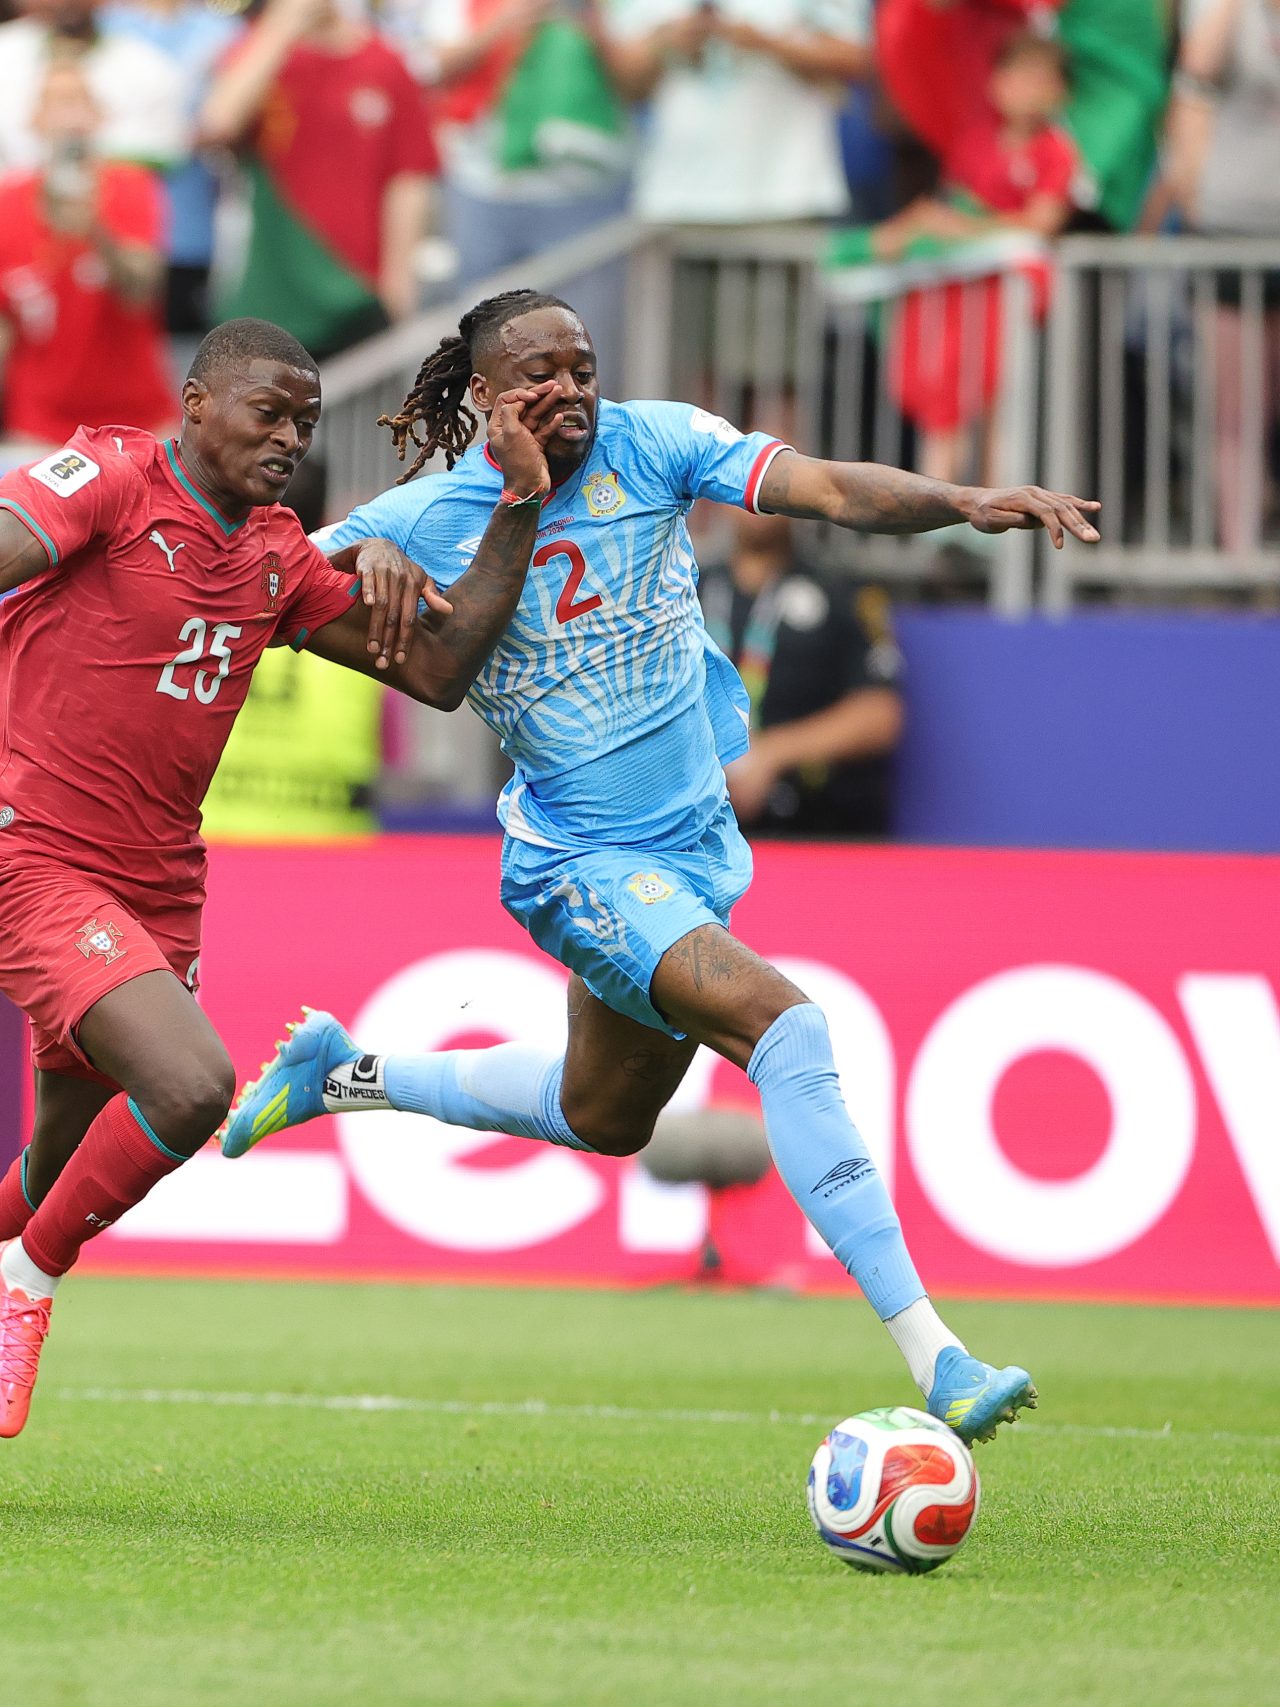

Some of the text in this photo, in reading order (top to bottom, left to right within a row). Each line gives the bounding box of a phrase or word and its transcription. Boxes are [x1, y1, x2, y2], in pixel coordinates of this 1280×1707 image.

[596, 500, 621, 514] FECOFA
[532, 539, 603, 625] 2
[155, 617, 243, 705] 25
